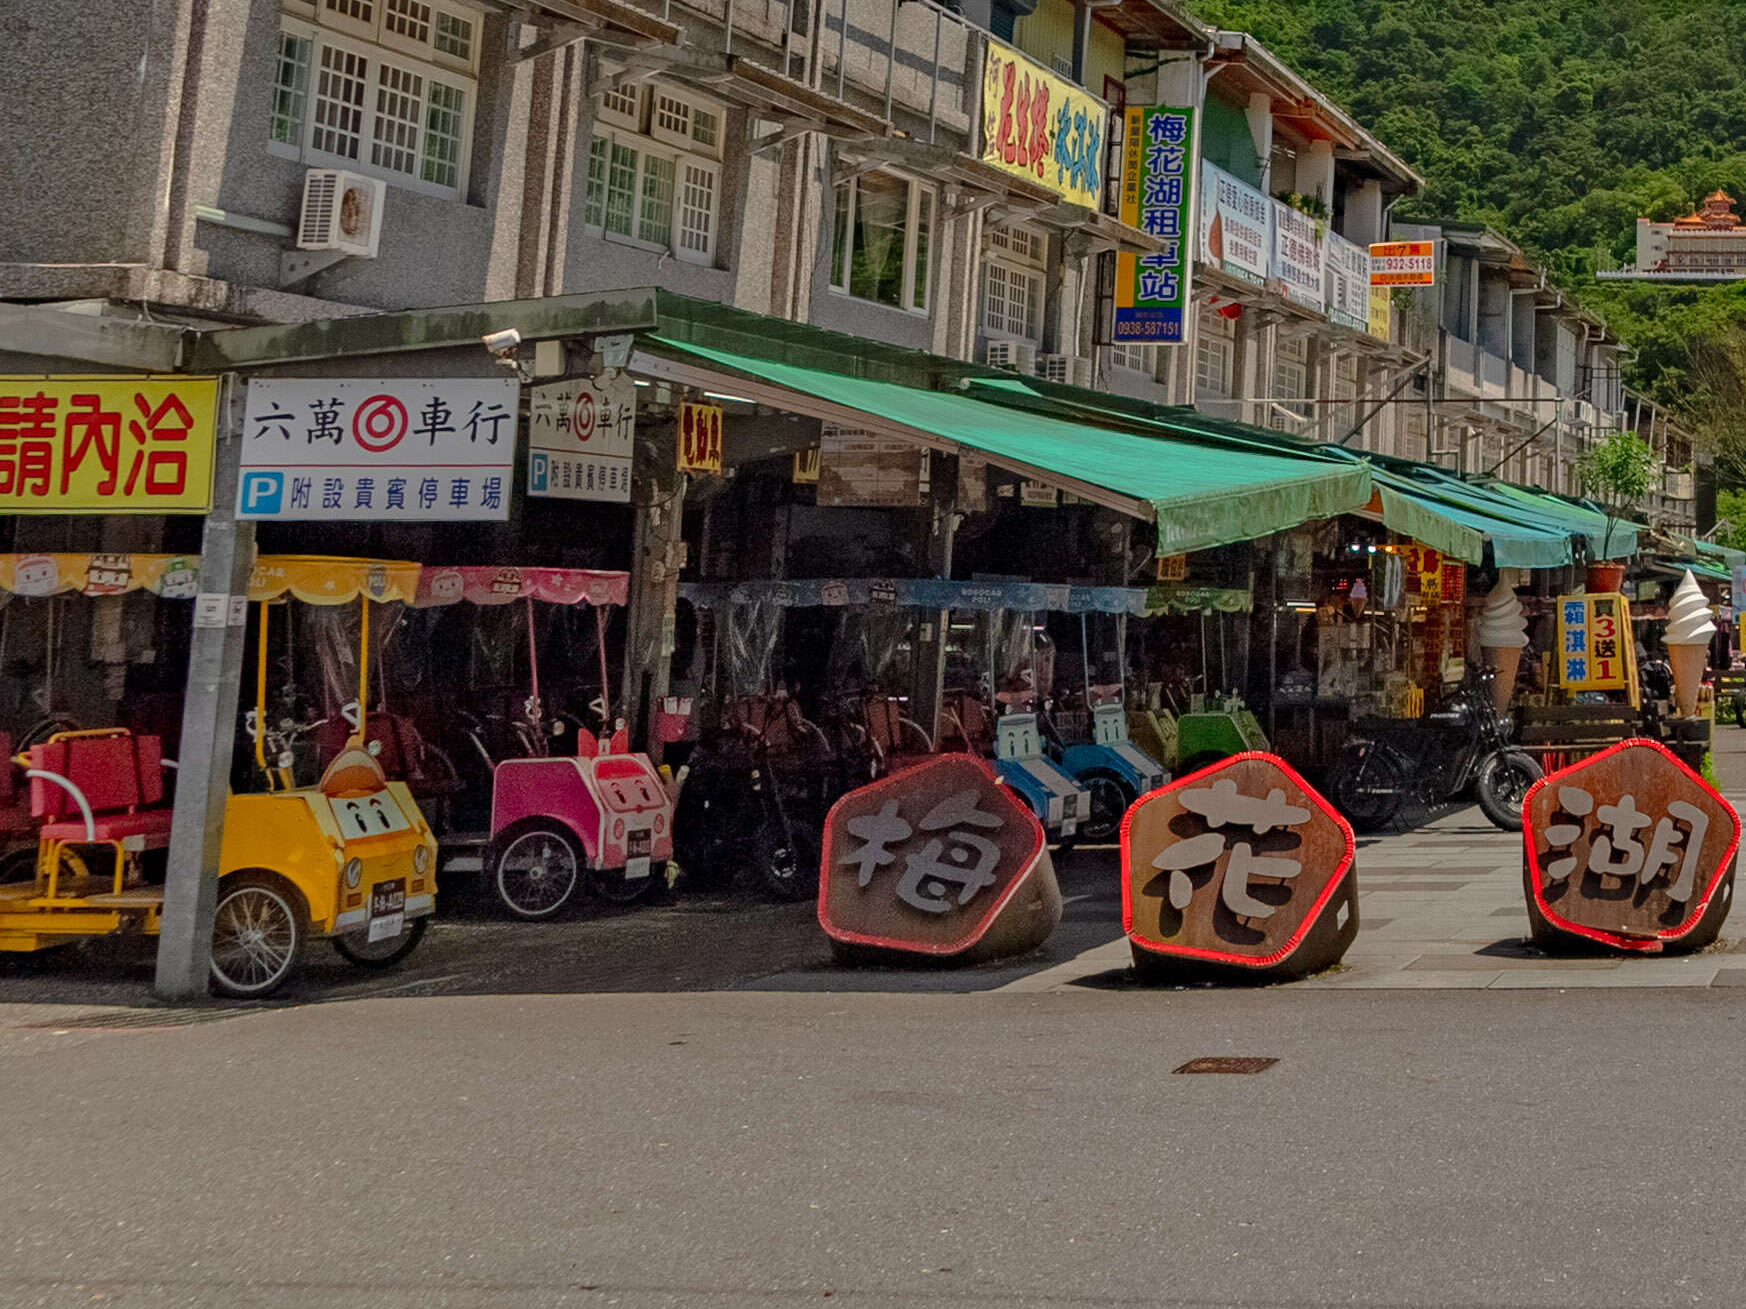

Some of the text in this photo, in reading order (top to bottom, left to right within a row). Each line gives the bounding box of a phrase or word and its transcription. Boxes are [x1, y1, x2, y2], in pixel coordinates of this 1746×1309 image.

[1387, 257, 1432, 270] 932-5118
[0, 392, 194, 496] 請內洽
[290, 477, 502, 510] 附設貴賓停車場
[1564, 601, 1587, 681] 霜淇淋
[837, 792, 1005, 914] 梅
[1151, 778, 1312, 919] 花
[1544, 785, 1709, 903] 湖
